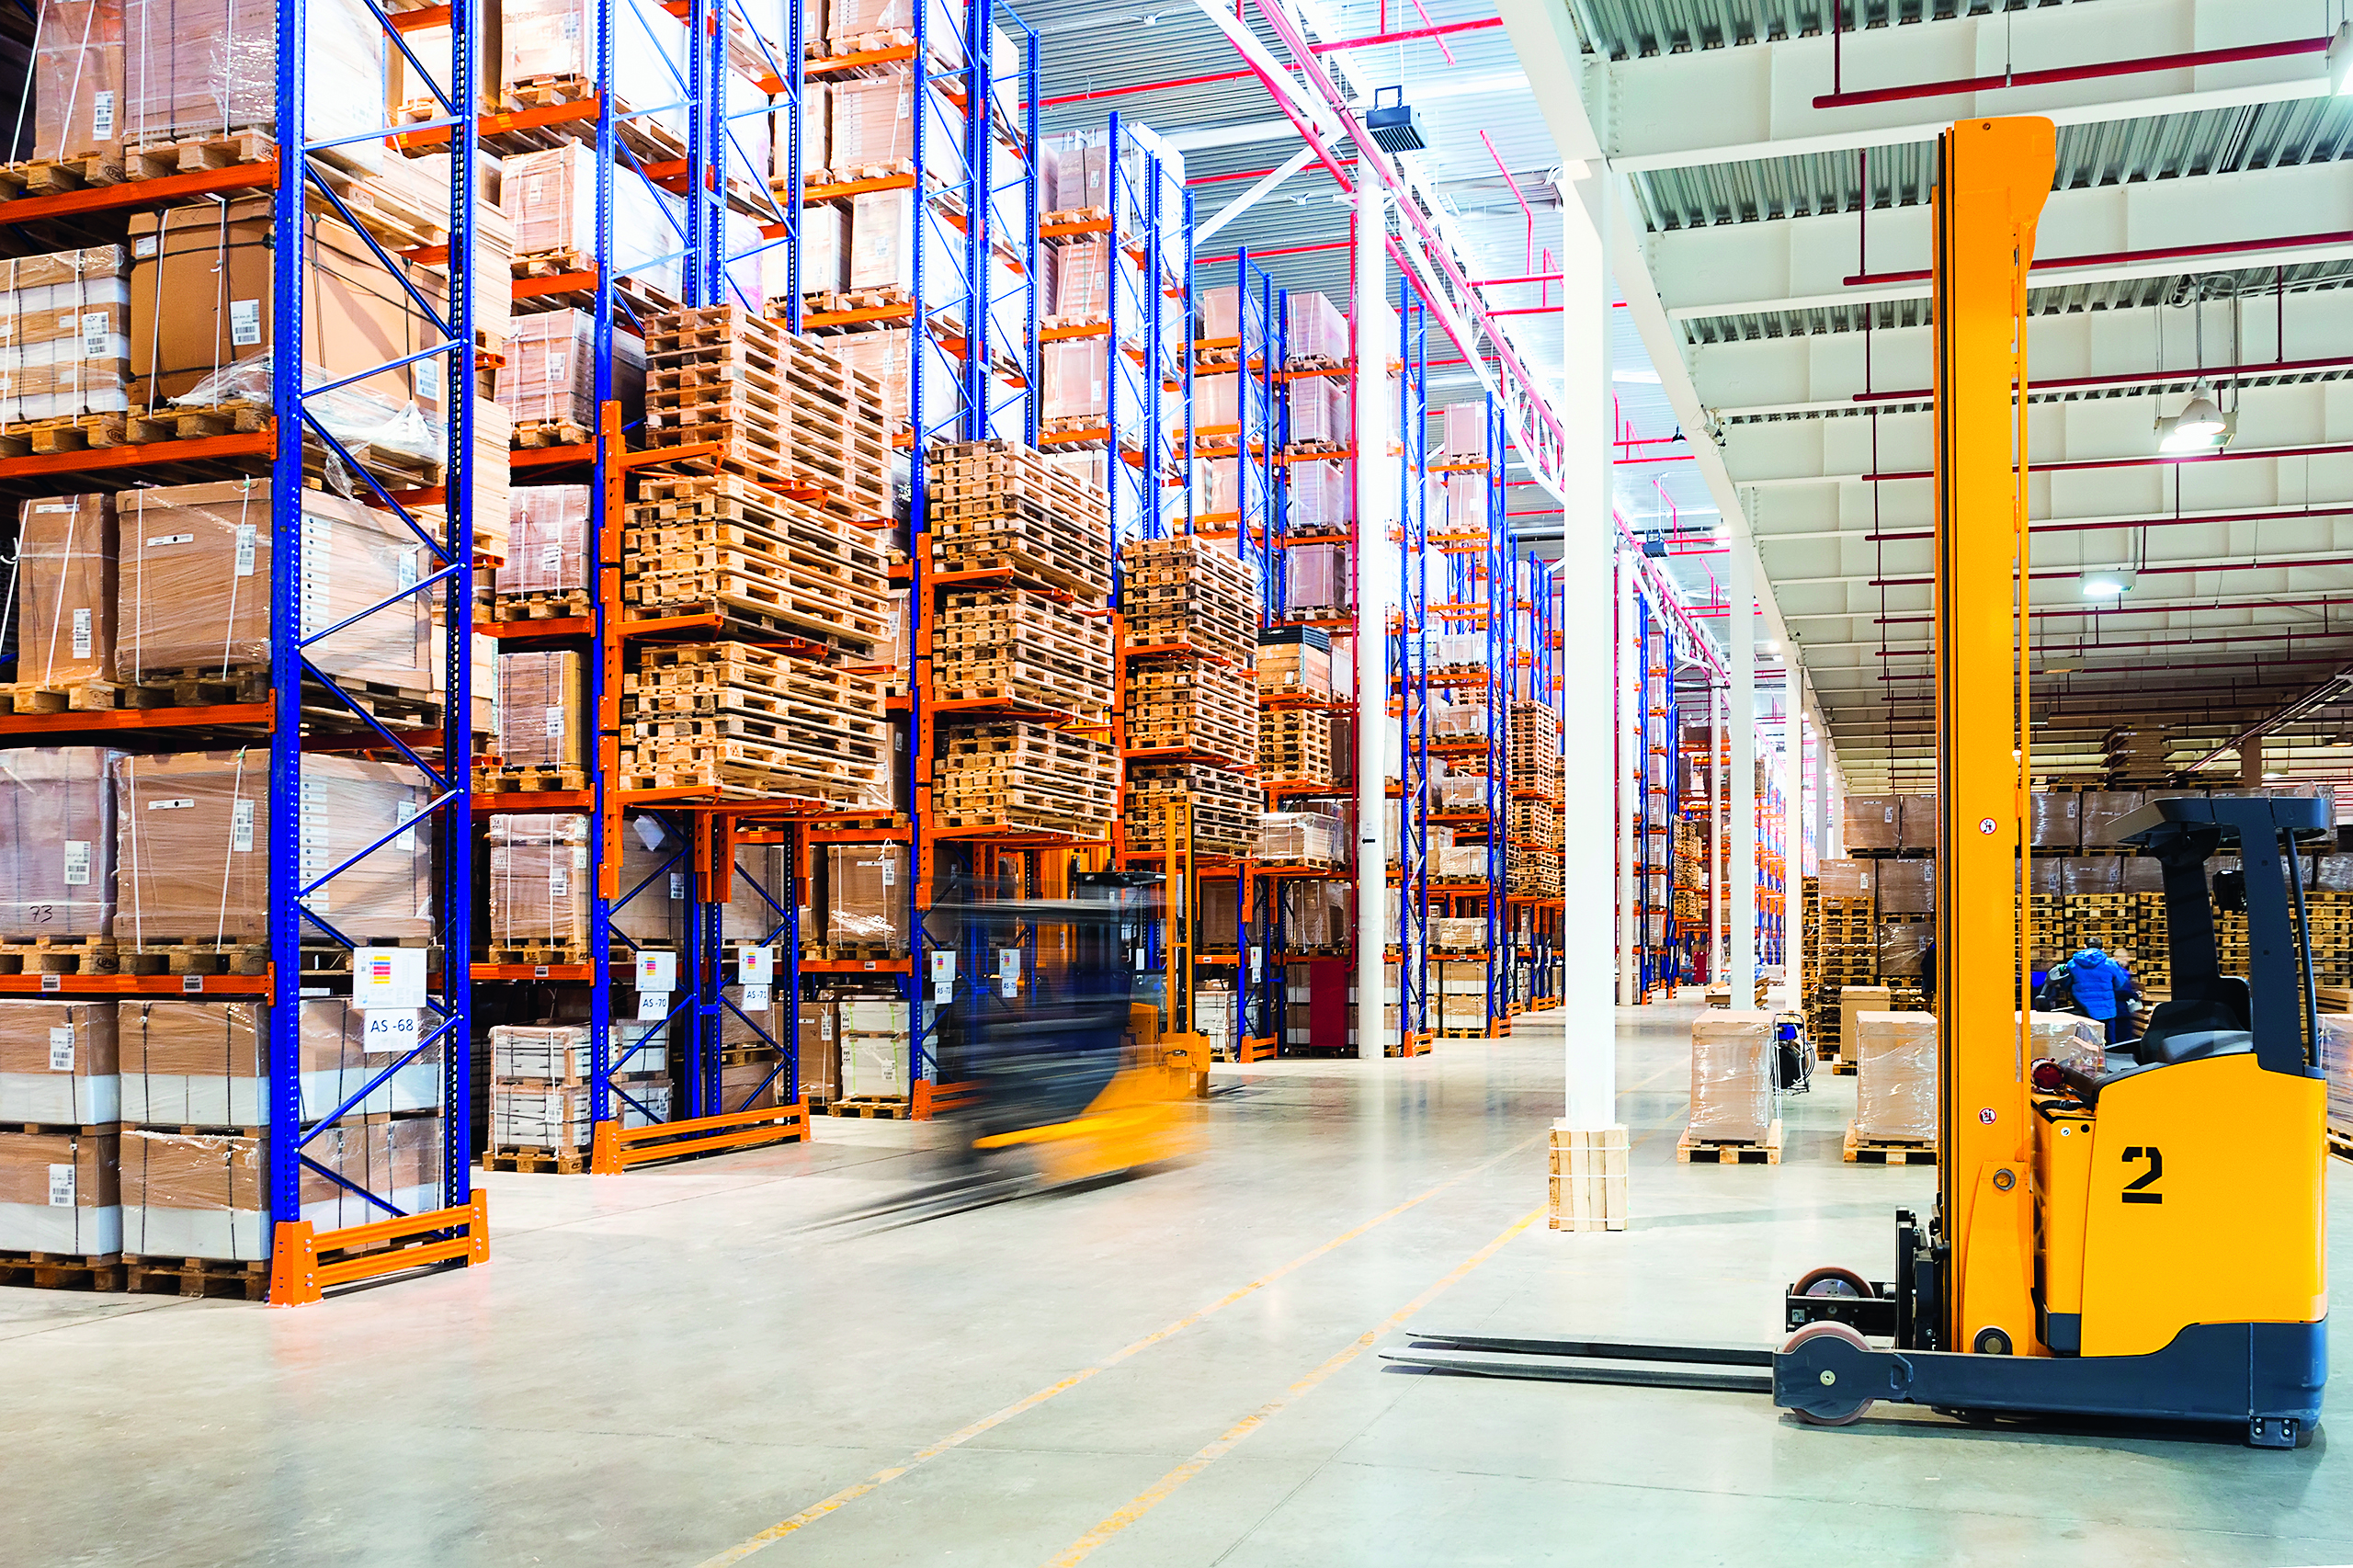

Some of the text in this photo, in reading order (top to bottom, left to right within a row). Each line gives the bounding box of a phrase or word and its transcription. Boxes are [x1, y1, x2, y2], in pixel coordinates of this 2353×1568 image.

[29, 904, 52, 923] 73
[746, 990, 767, 999] AS -71
[937, 986, 943, 994] AS
[642, 998, 667, 1007] AS -70
[370, 1018, 414, 1032] AS -68
[2121, 1146, 2163, 1204] 2
